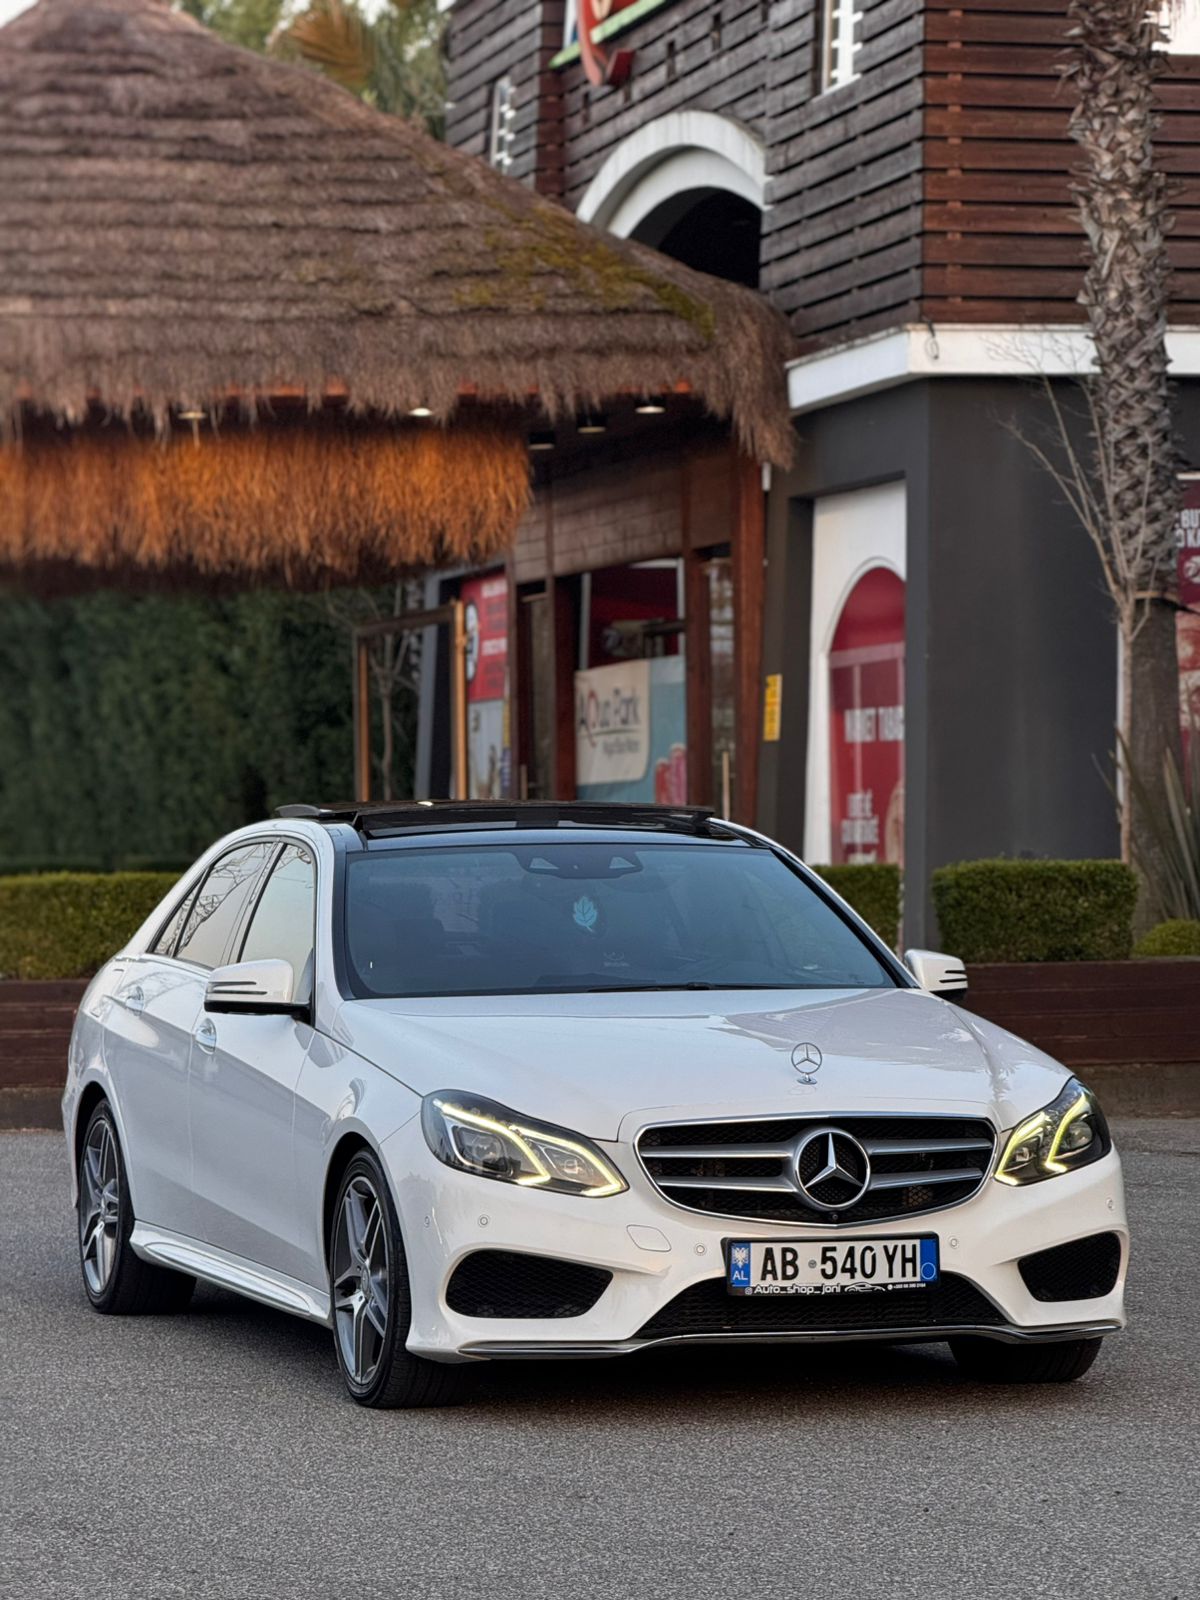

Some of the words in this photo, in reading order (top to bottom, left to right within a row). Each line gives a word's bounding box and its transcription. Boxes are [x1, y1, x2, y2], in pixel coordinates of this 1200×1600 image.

[760, 1247, 799, 1281] AB
[820, 1245, 877, 1280] 540
[883, 1243, 917, 1278] YH
[732, 1271, 749, 1281] AL
